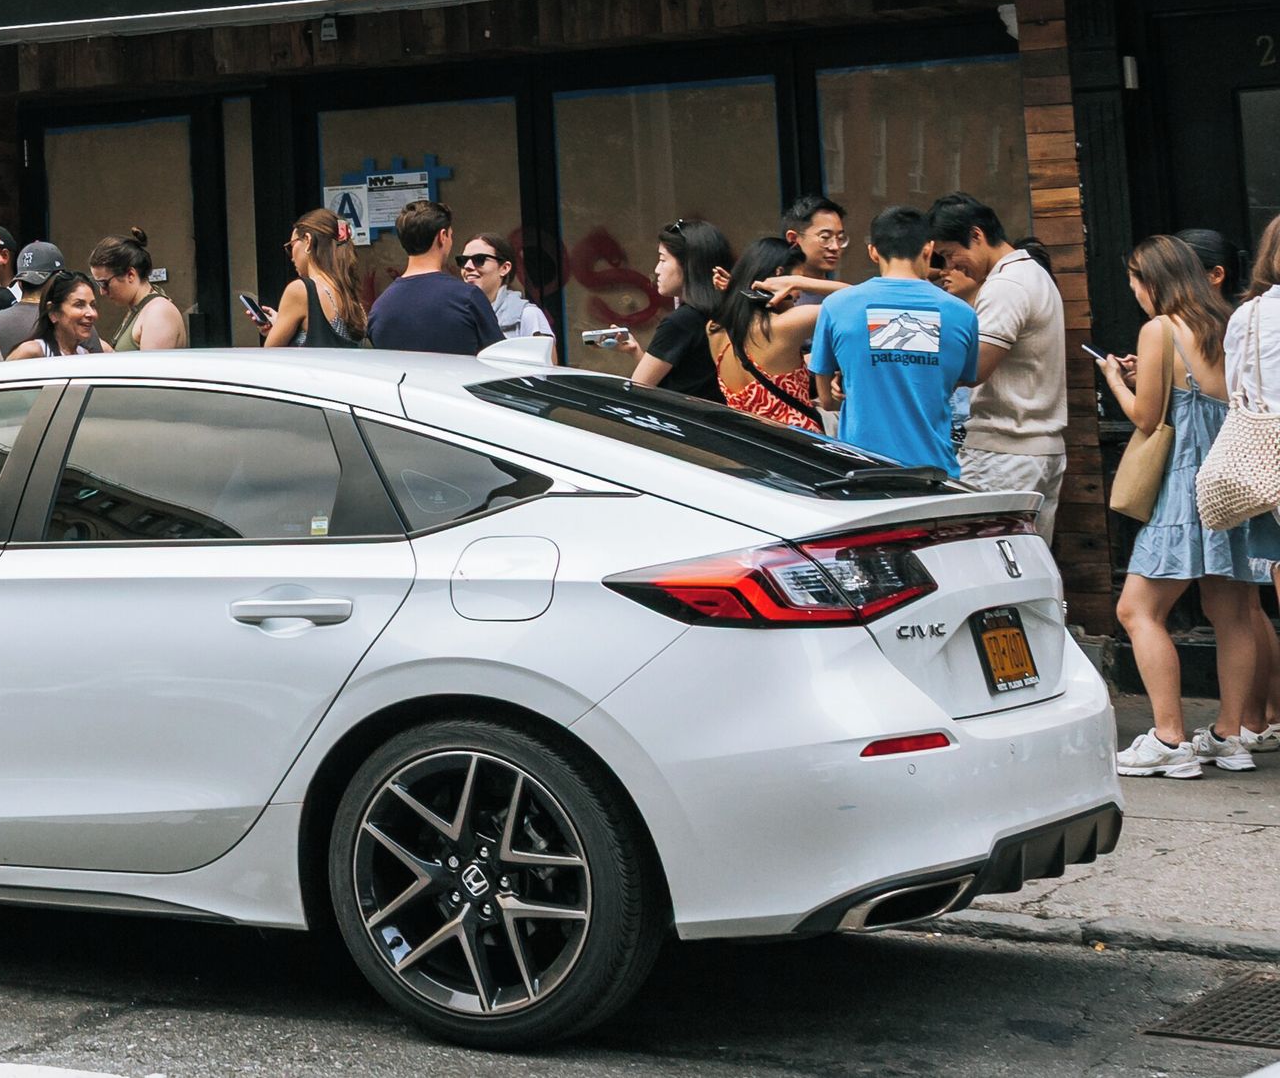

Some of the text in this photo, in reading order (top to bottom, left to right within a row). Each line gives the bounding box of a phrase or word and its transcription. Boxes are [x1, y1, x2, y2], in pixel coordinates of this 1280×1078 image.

[368, 175, 394, 187] NYC
[337, 191, 362, 228] A
[871, 352, 940, 367] patagonia
[896, 623, 947, 639] CIVIC
